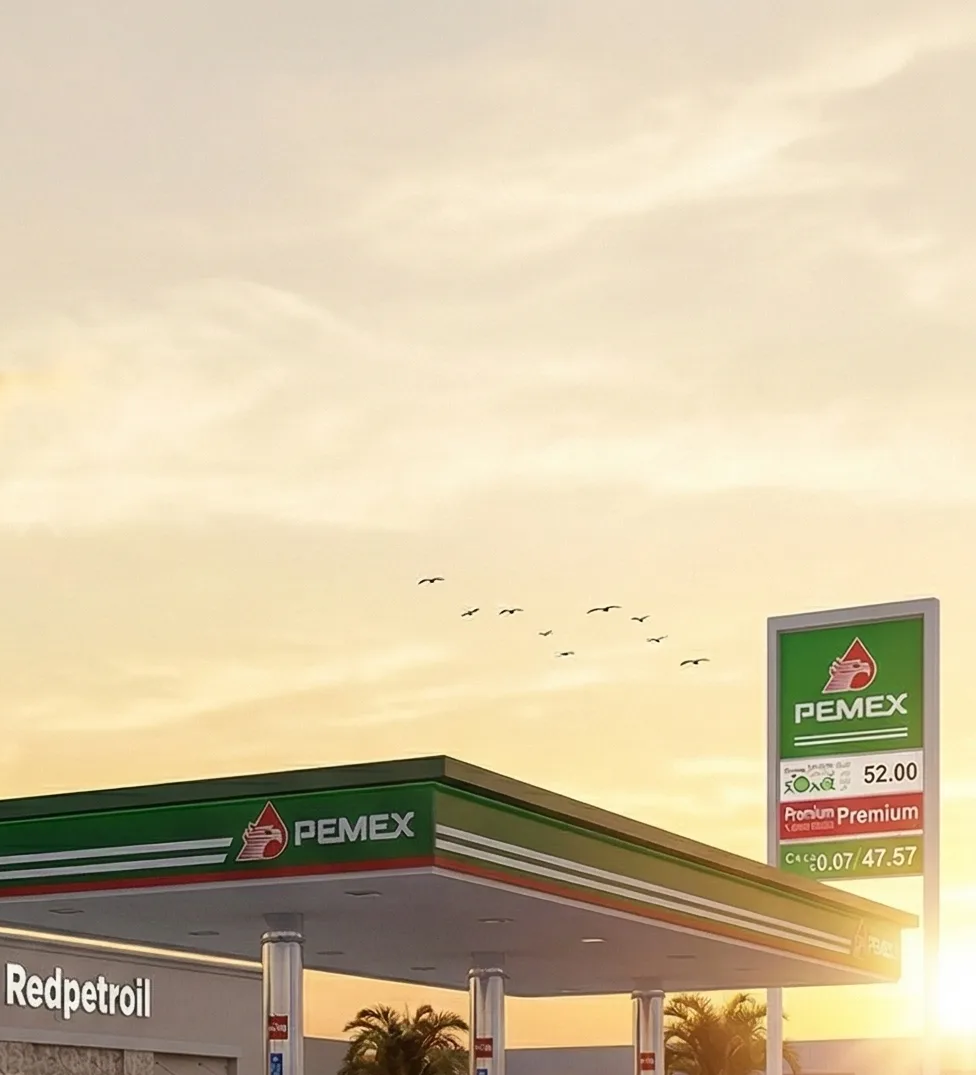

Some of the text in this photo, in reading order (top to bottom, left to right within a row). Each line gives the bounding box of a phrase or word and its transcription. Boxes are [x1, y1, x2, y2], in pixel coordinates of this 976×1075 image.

[794, 693, 908, 724] PEMEX
[864, 762, 918, 784] 52.00
[294, 811, 415, 846] PEMEX
[837, 803, 919, 825] Premium
[6, 963, 151, 1020] Redpetroil
